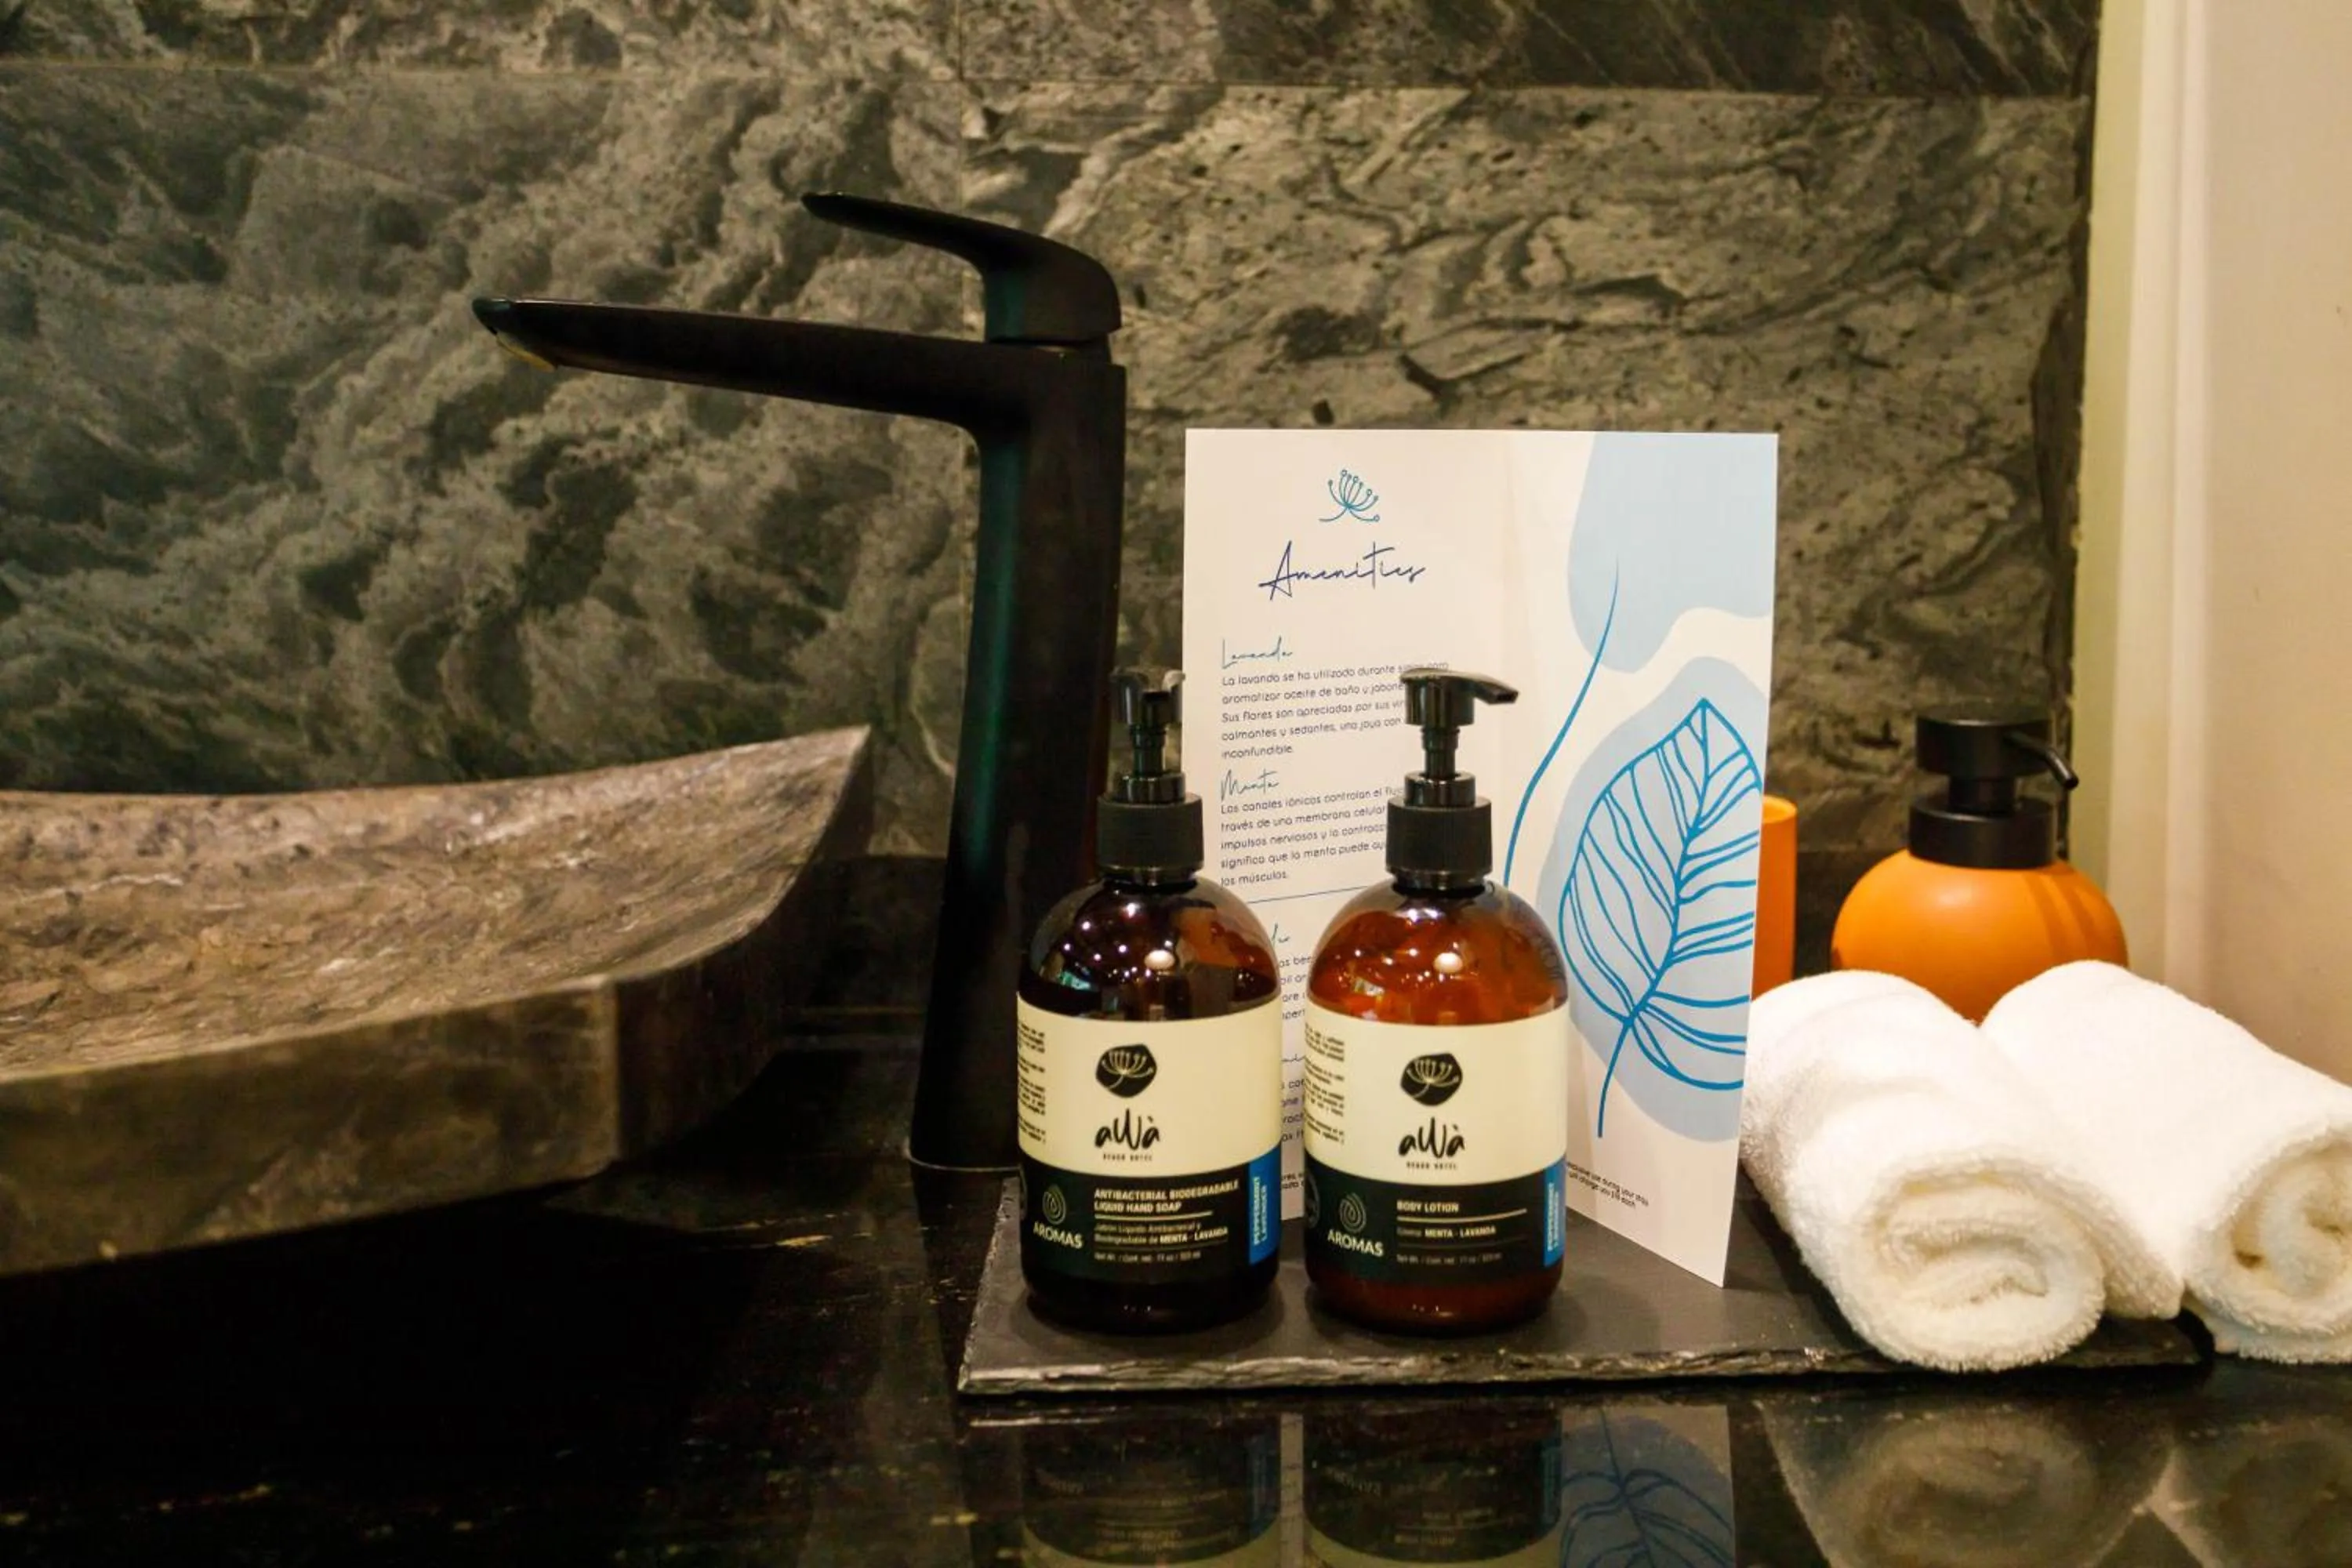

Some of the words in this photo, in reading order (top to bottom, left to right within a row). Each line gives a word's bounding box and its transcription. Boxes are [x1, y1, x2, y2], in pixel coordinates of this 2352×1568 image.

[1258, 540, 1426, 600] Amenities
[1223, 677, 1235, 686] La
[1238, 674, 1279, 685] lavanda
[1298, 671, 1310, 681] ha
[1314, 668, 1356, 680] utilizado
[1358, 665, 1397, 676] durante
[1222, 692, 1280, 704] aromatizar
[1284, 688, 1316, 700] aceite
[1319, 687, 1331, 697] de
[1336, 684, 1359, 695] baño
[1371, 682, 1405, 694] jabone
[1222, 713, 1240, 723] Sus
[1243, 710, 1272, 720] flores
[1276, 710, 1293, 718] son
[1297, 703, 1352, 717] apreciadas
[1356, 702, 1372, 713] por
[1375, 701, 1389, 710] sus
[1222, 726, 1277, 741] calmantes
[1340, 721, 1358, 730] una
[1359, 719, 1381, 731] joya
[1221, 804, 1239, 815] Los
[1242, 801, 1283, 812] canales
[1324, 791, 1370, 804] controlan
[1374, 788, 1382, 797] el
[1221, 821, 1254, 832] través
[1257, 818, 1270, 828] de
[1274, 817, 1293, 826] una
[1295, 811, 1351, 823] membrana
[1221, 837, 1266, 850] impulsos
[1269, 831, 1317, 844] nerviosos
[1221, 855, 1265, 869] significa
[1268, 852, 1288, 864] que
[1304, 845, 1337, 858] menta
[1339, 841, 1370, 855] puede
[1094, 1189, 1167, 1201] ANTIBACTERIAL
[1170, 1179, 1240, 1200] BIODEGRADABLE
[1094, 1201, 1124, 1212] LIQUID
[1127, 1203, 1153, 1213] HAND
[1156, 1202, 1182, 1213] SOAP
[1396, 1200, 1421, 1212] BODY
[1425, 1202, 1459, 1214] LOTION
[1033, 1221, 1083, 1249] AROMAS
[1160, 1233, 1188, 1244] MENTA
[1194, 1226, 1229, 1240] LAVANDA
[1327, 1229, 1384, 1257] AROMAS
[1425, 1229, 1454, 1239] MENTA
[1460, 1225, 1497, 1239] LAVANDA
